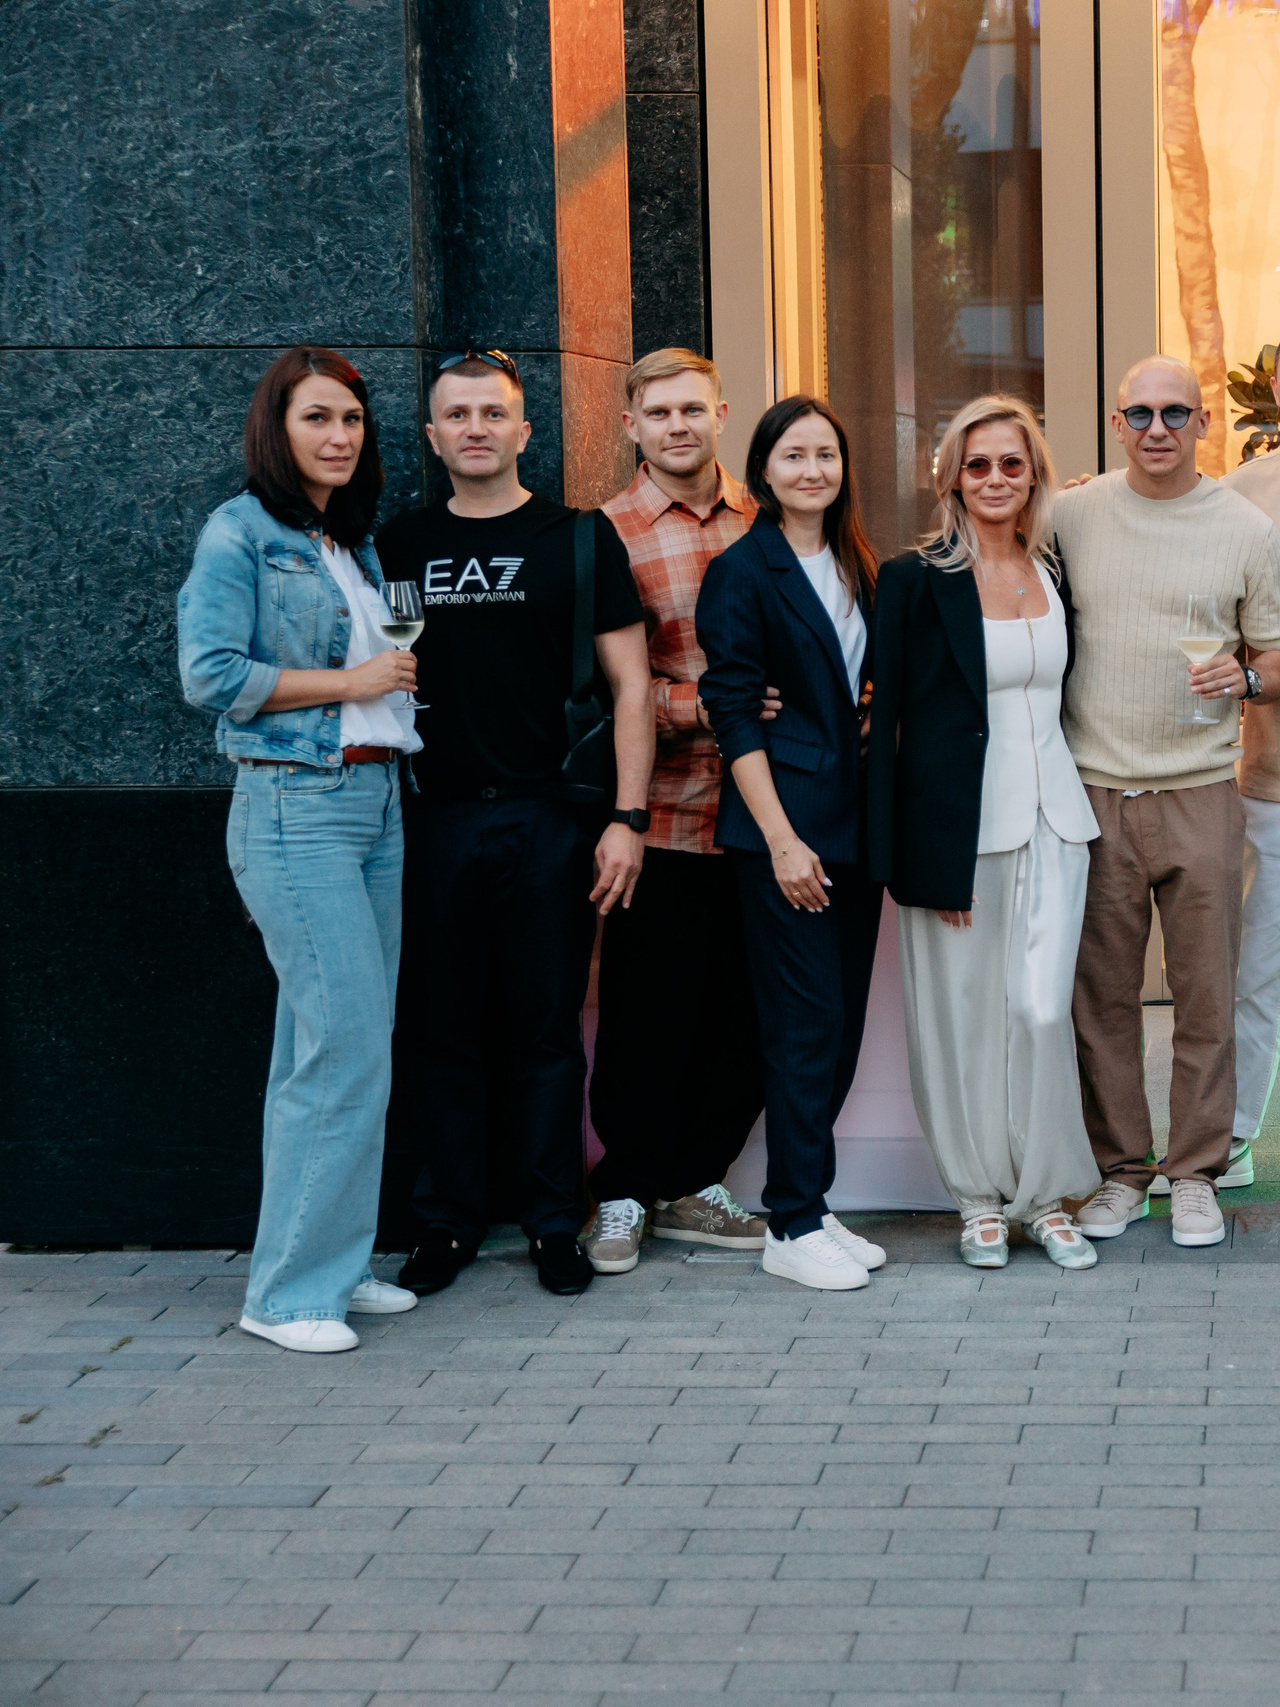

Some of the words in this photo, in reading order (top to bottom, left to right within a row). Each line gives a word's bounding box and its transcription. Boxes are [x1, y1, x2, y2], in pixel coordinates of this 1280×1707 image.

[425, 557, 525, 593] EA7
[425, 594, 471, 605] EMPORIO
[486, 591, 525, 602] ARMANI
